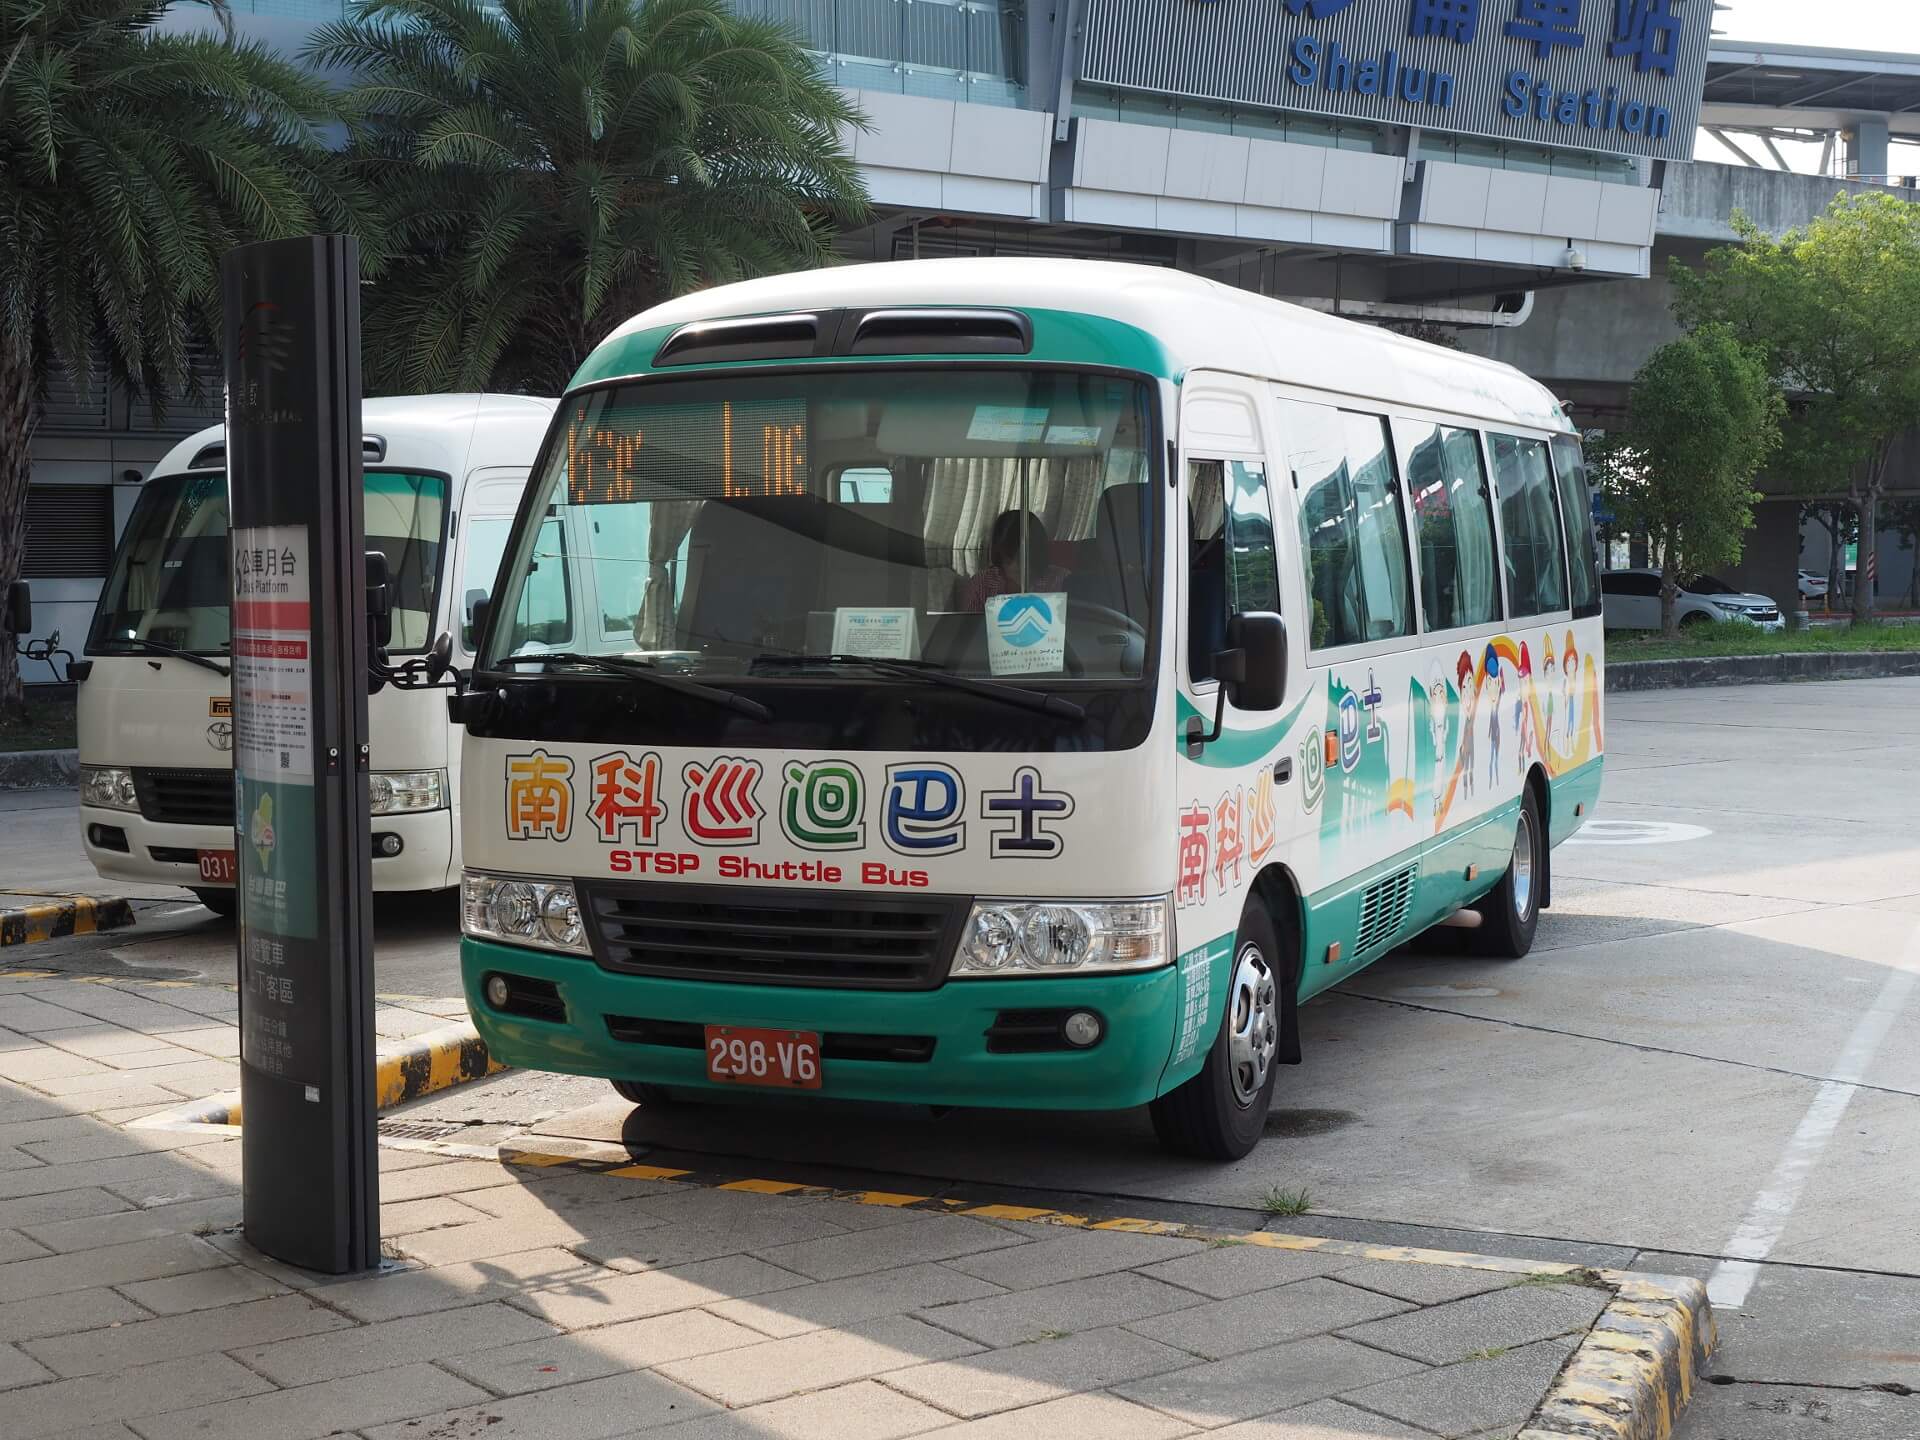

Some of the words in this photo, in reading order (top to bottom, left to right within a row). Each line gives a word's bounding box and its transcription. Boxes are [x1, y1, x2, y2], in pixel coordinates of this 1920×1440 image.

[1282, 0, 1683, 78] 車站
[1288, 34, 1455, 108] Shalun
[1502, 69, 1672, 139] Station
[241, 546, 297, 577] 公車月台
[255, 579, 289, 594] Platform
[505, 748, 1076, 859] 南科巡迴巴士
[609, 849, 700, 875] STSP
[718, 855, 842, 882] Shuttle
[861, 862, 929, 888] Bus
[710, 1037, 816, 1080] 298-V6
